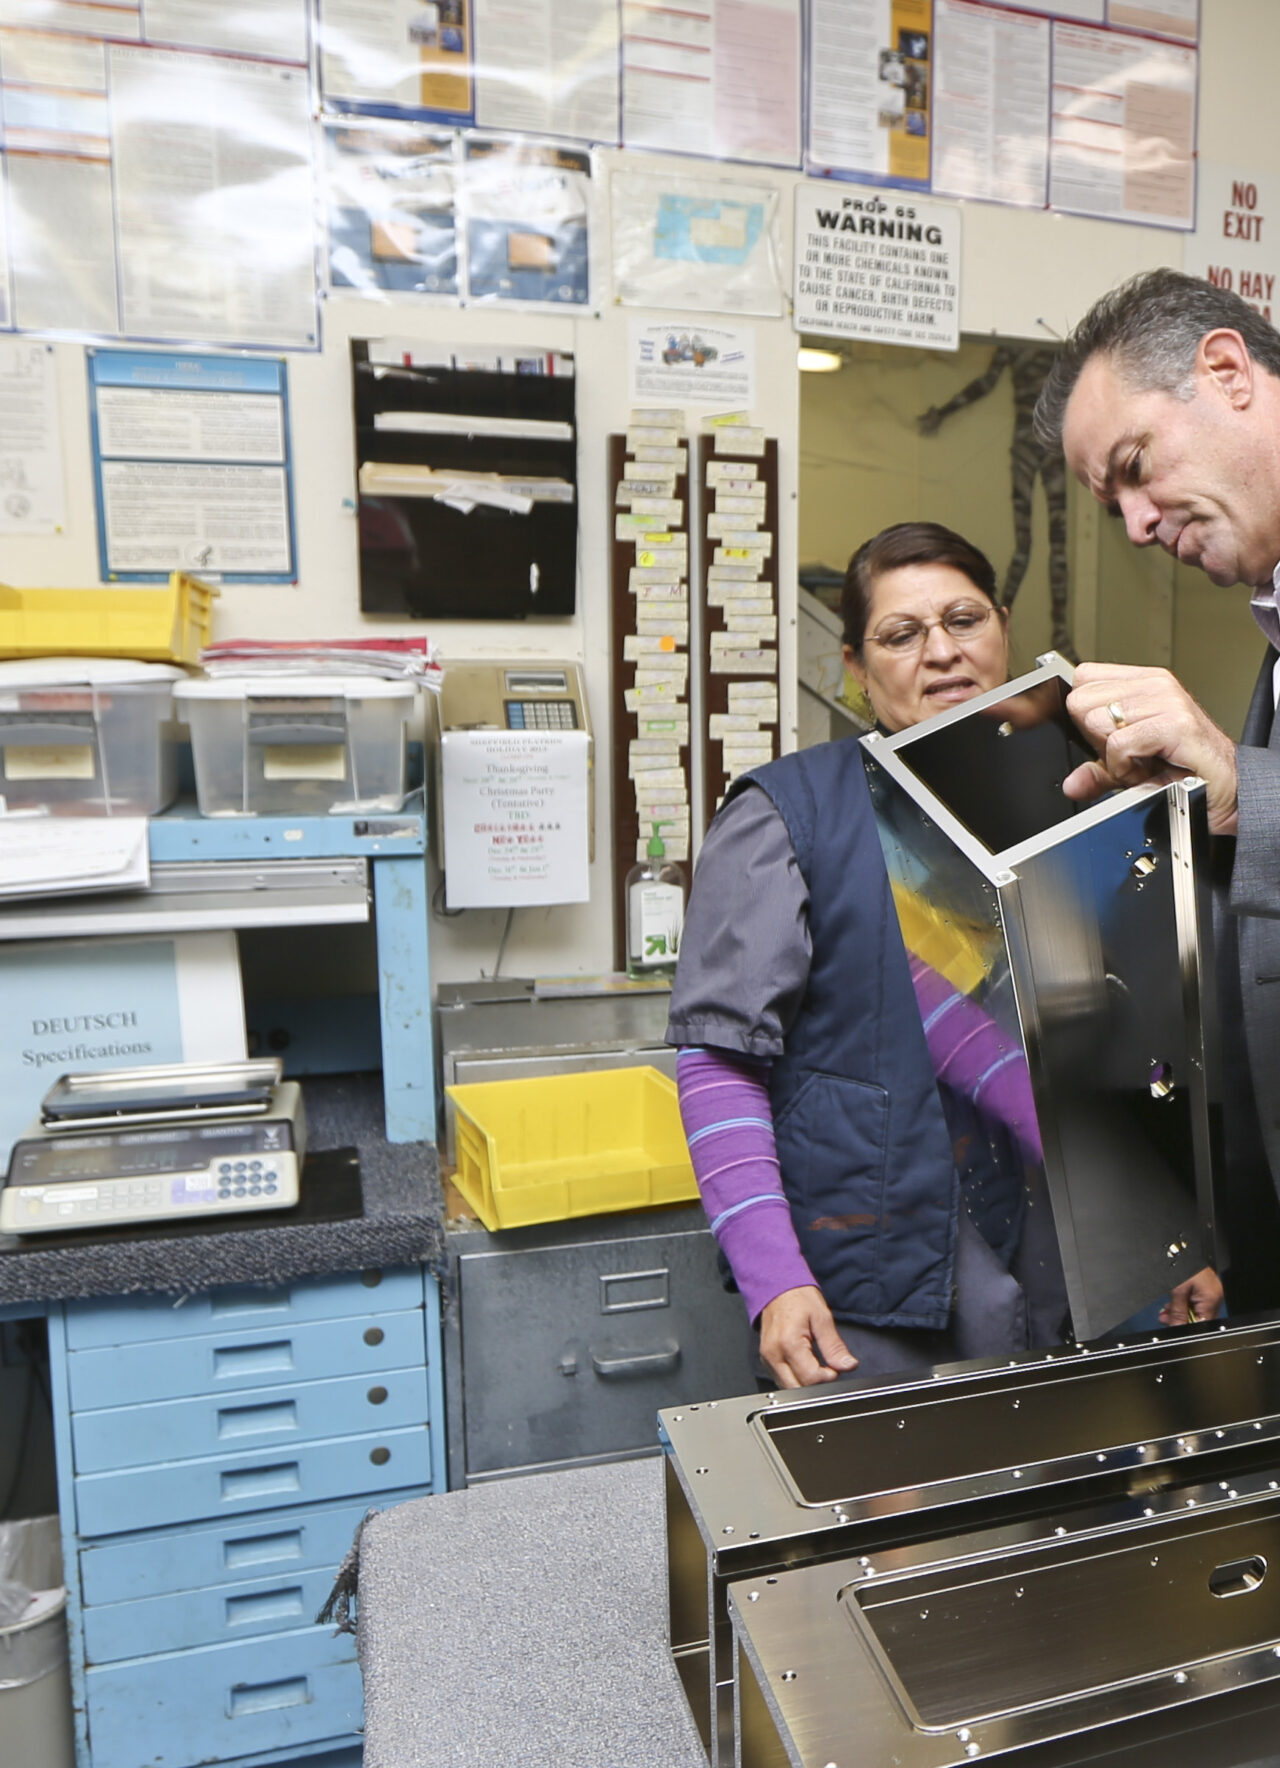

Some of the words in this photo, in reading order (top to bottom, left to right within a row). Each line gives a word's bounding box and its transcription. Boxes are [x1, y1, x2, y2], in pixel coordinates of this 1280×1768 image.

[842, 198, 888, 214] PROP
[895, 206, 916, 219] 65
[1232, 180, 1257, 210] NO
[816, 208, 942, 245] WARNING
[1223, 210, 1264, 242] EXIT
[807, 233, 829, 248] THIS
[833, 236, 875, 254] FACILITY
[879, 244, 926, 262] CONTAINS
[930, 250, 949, 265] ONE
[806, 250, 819, 262] OR
[823, 251, 851, 266] MORE
[855, 255, 910, 275] CHEMICALS
[914, 264, 949, 280] KNOWN
[800, 264, 810, 278] TO
[815, 266, 832, 281] THE
[837, 268, 865, 284] STATE
[870, 274, 882, 286] OF
[885, 276, 940, 296] CALIFORNIA
[944, 284, 955, 297] TO
[1208, 264, 1232, 291] NO
[1240, 270, 1276, 300] HAY
[800, 280, 832, 296] CAUSE
[882, 291, 908, 306] BIRTH
[912, 295, 953, 312] DEFECTS
[816, 298, 828, 312] OR
[832, 300, 904, 322] REPRODUCTIVE
[486, 764, 549, 775] Thanksgiving
[480, 786, 528, 797] Christmas
[531, 785, 555, 796] Party
[32, 1010, 138, 1036] DEUTSCH
[22, 1039, 152, 1068] Specifications
